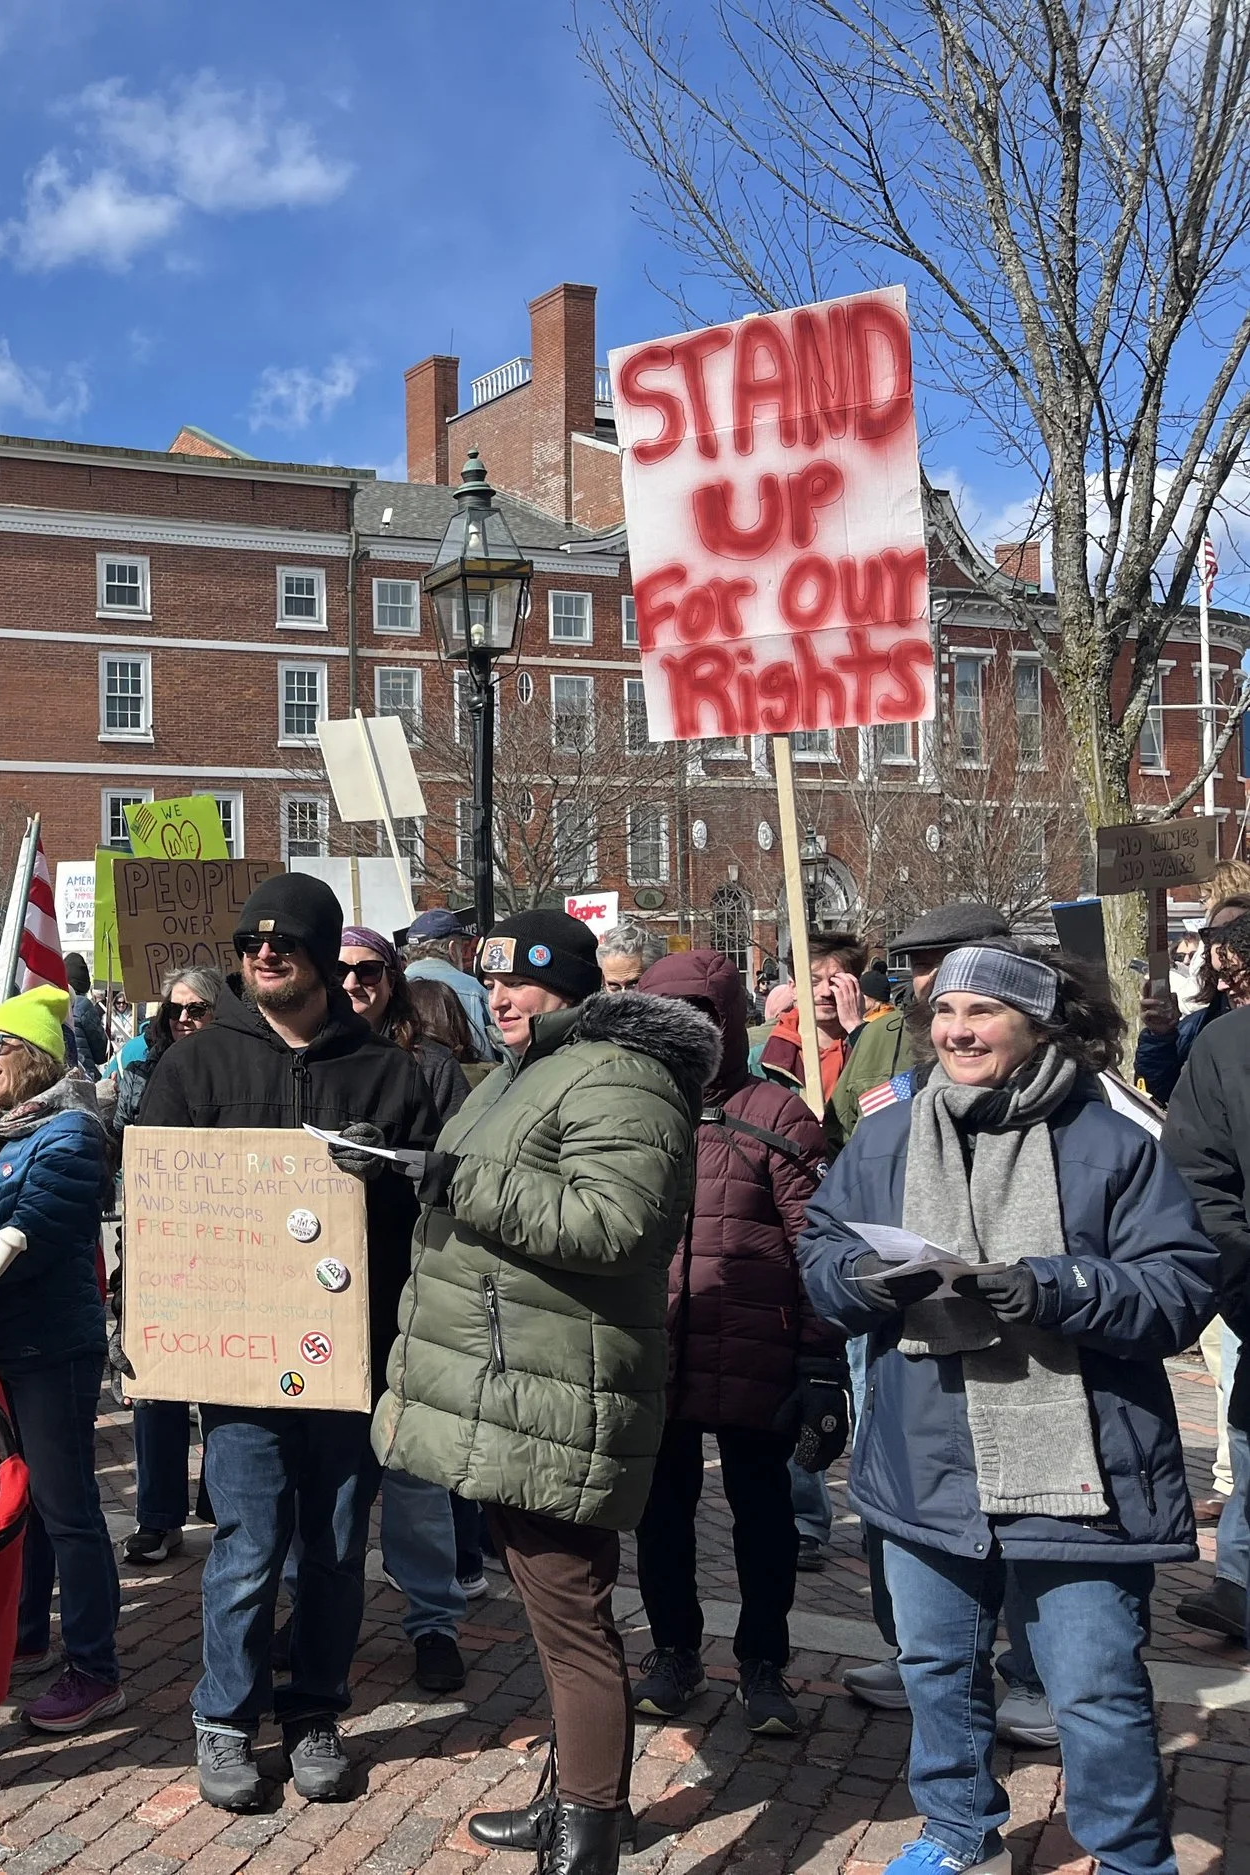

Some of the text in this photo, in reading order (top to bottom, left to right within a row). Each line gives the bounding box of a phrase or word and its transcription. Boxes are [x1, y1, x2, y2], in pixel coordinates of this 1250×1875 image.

[621, 303, 912, 465] STAND
[693, 459, 844, 561] UP
[635, 562, 757, 652] For
[660, 627, 933, 740] Rights
[161, 804, 182, 819] WE
[167, 834, 196, 857] LOVE
[1116, 828, 1199, 858] NO KINGS
[66, 875, 94, 886] AMERI
[1119, 853, 1196, 883] NO WARS
[163, 916, 216, 935] OVER
[145, 942, 234, 995] PROF
[135, 1149, 344, 1175] THE ONLY TRANS FOL
[134, 1172, 355, 1195] IN THE FILES ARE VICTIMS
[137, 1193, 174, 1212] AND
[137, 1219, 187, 1238] FREE
[282, 1264, 296, 1279] IS
[144, 1325, 277, 1364] FUCK ICE!
